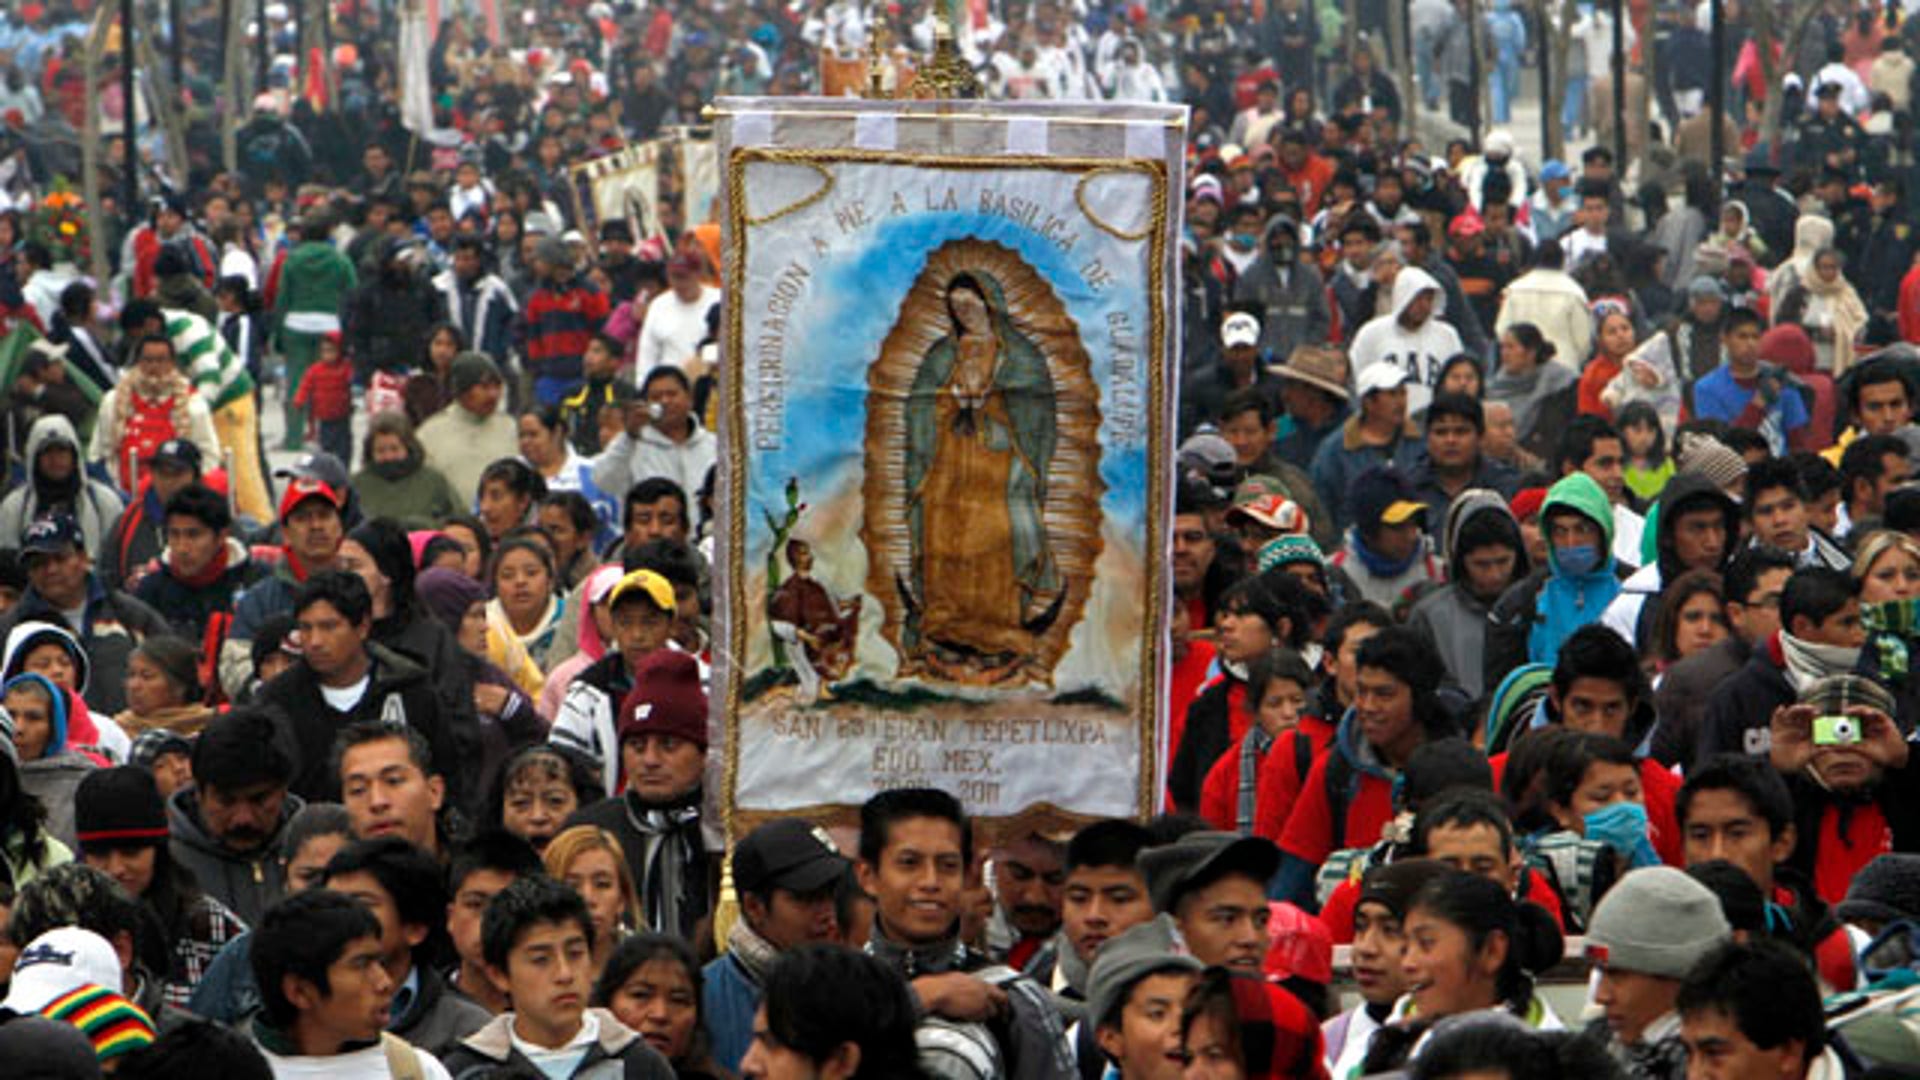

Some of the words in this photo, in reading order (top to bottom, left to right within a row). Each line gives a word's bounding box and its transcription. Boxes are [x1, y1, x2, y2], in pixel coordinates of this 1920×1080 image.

[812, 236, 830, 259] A
[835, 199, 873, 234] PIE
[890, 191, 908, 214] A
[926, 186, 958, 211] LA
[978, 188, 1080, 254] BASILICA
[1080, 259, 1114, 292] DE
[772, 711, 822, 740] SAN
[836, 716, 947, 742] ESTEBAN
[963, 718, 1107, 745] TEPETLIXPA
[941, 748, 1003, 775] MEX.
